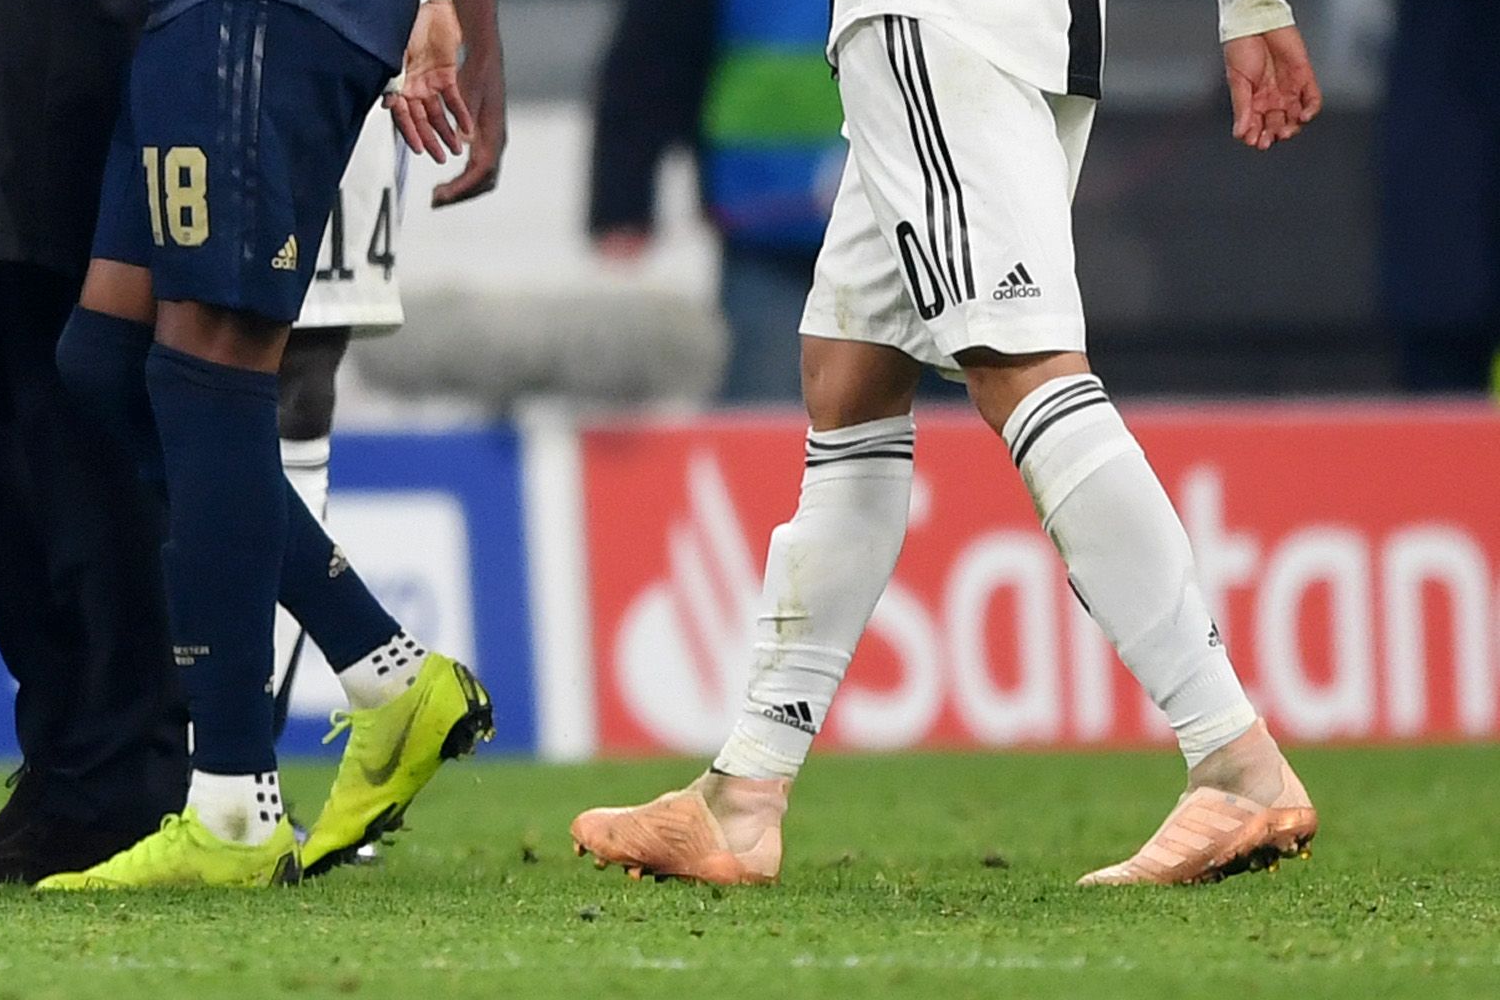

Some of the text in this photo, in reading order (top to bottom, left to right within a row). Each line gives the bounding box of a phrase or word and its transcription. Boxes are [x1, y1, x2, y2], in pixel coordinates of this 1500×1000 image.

[142, 146, 210, 246] 18
[315, 186, 395, 282] 14
[992, 285, 1041, 301] adidas
